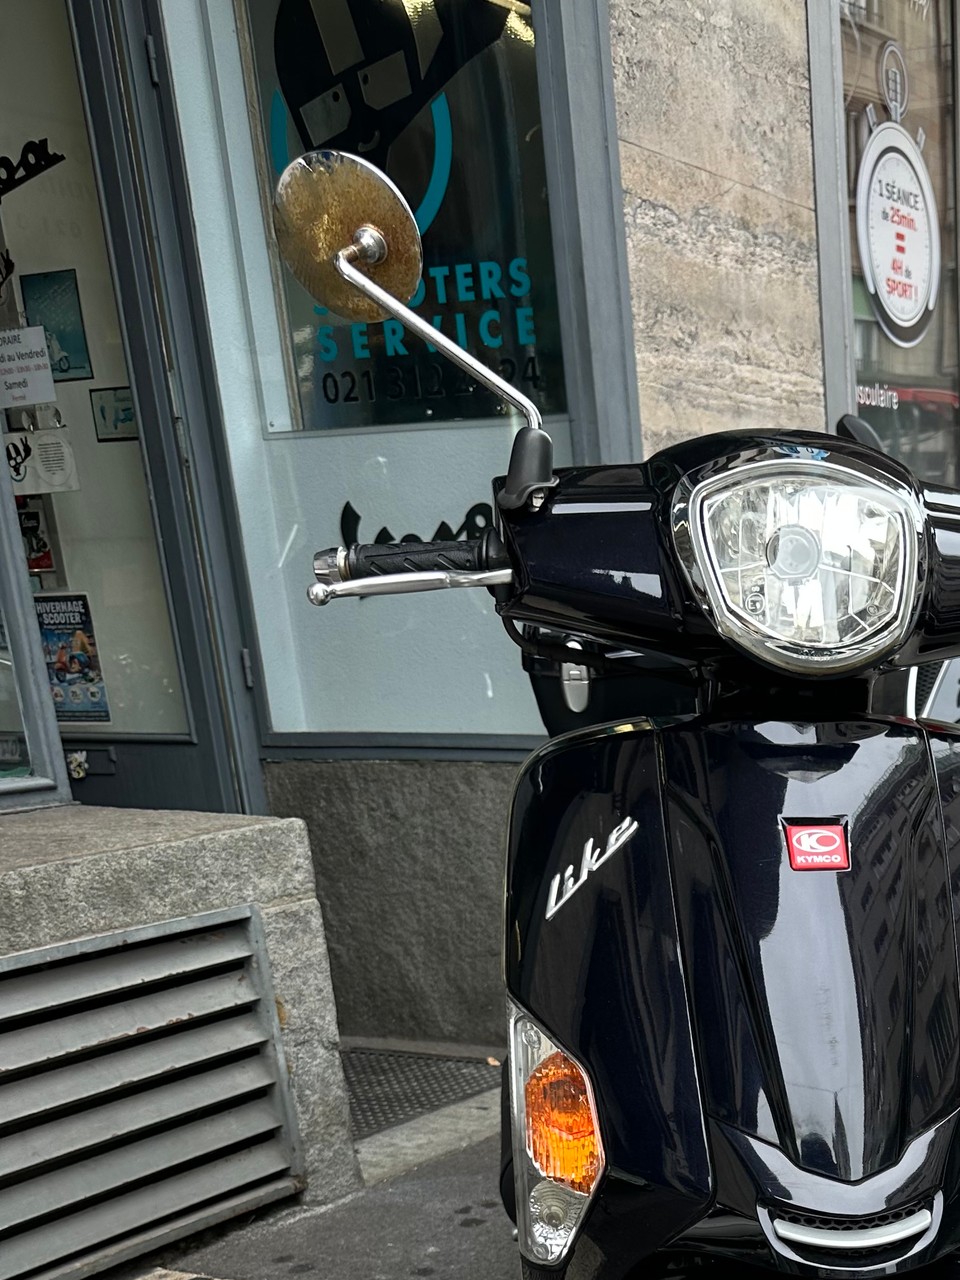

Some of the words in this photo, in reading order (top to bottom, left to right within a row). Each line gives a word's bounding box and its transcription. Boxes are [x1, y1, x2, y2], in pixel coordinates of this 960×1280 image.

[885, 180, 920, 211] SÉANCE
[885, 277, 913, 301] SPORT
[316, 306, 537, 363] SERVICE
[16, 347, 47, 361] Vendredi
[4, 378, 29, 391] Samedi
[322, 370, 376, 404] 021
[855, 382, 899, 410] sculaire
[36, 600, 85, 614] HIVERNAGE
[43, 612, 82, 625] SCOOTER
[796, 854, 842, 864] KYMCO
